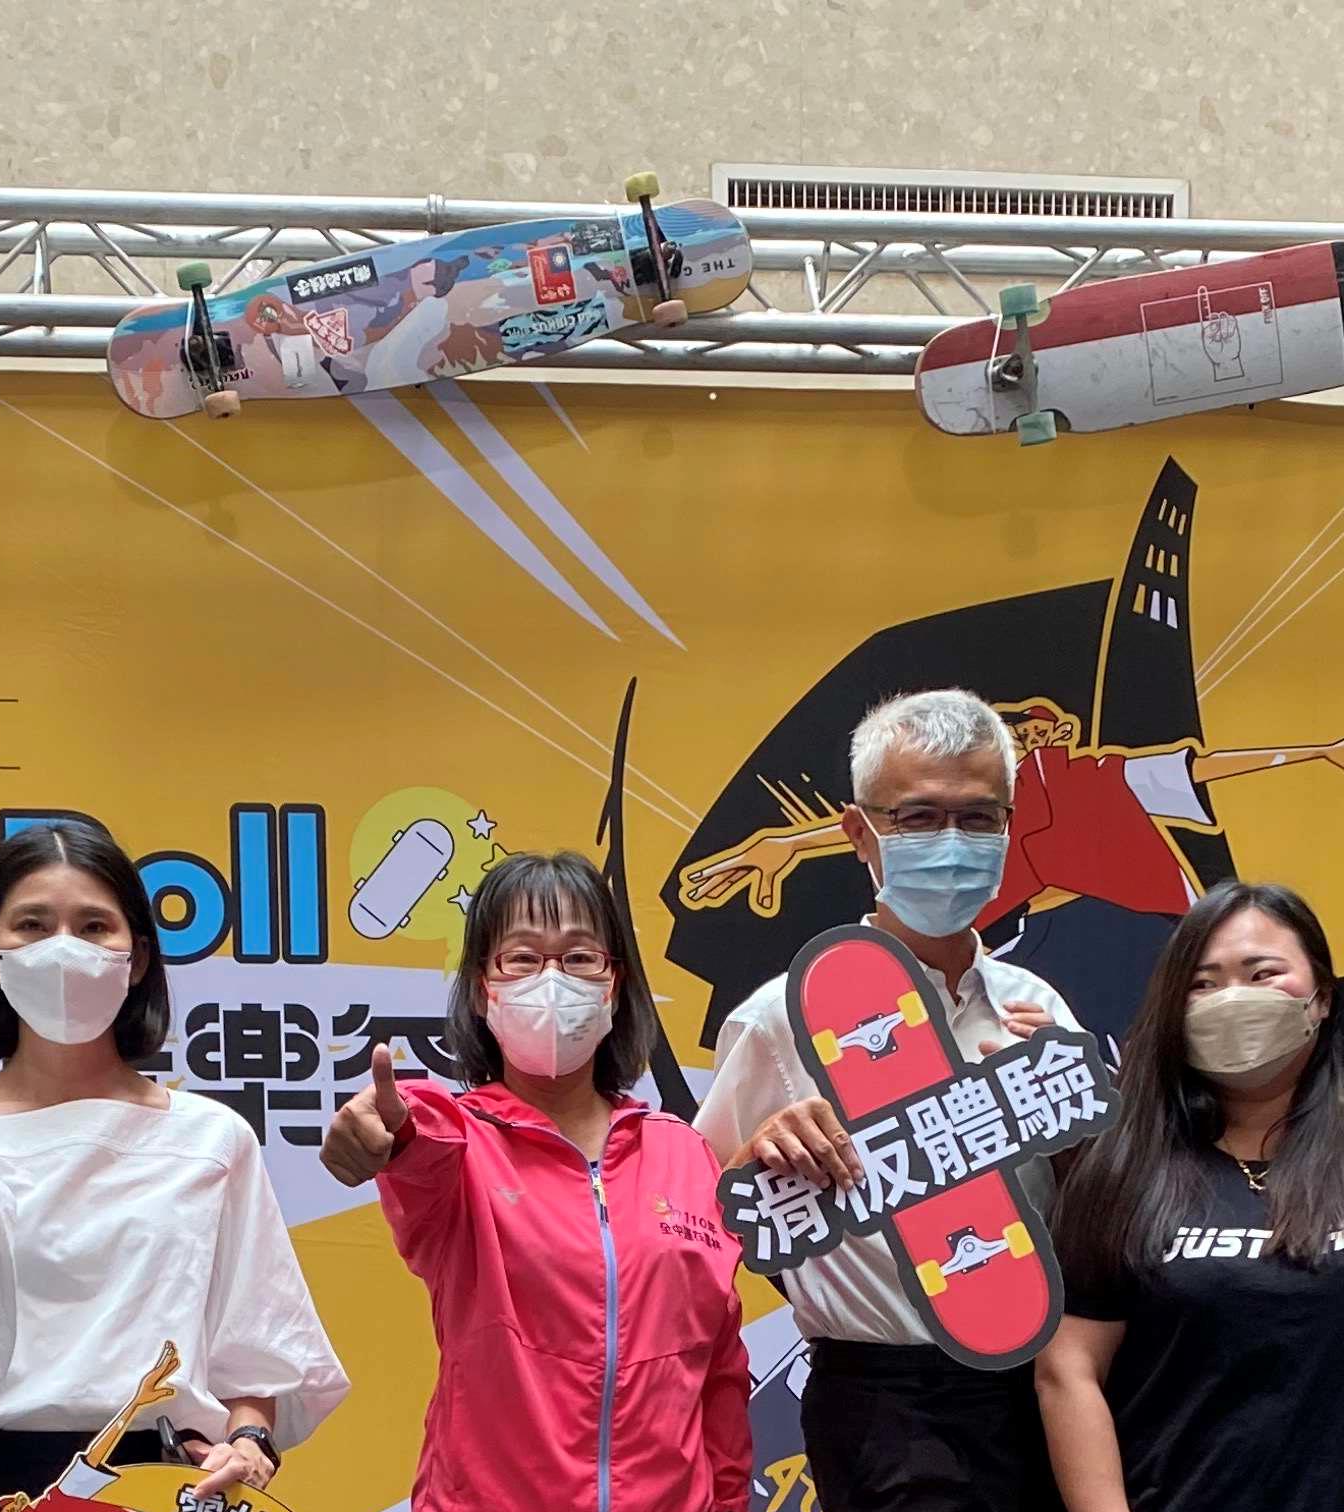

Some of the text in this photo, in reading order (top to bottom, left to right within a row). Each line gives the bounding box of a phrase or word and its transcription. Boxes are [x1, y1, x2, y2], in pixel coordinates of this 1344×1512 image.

[731, 1040, 1109, 1261] 滑板體驗
[1162, 1226, 1273, 1264] JUST
